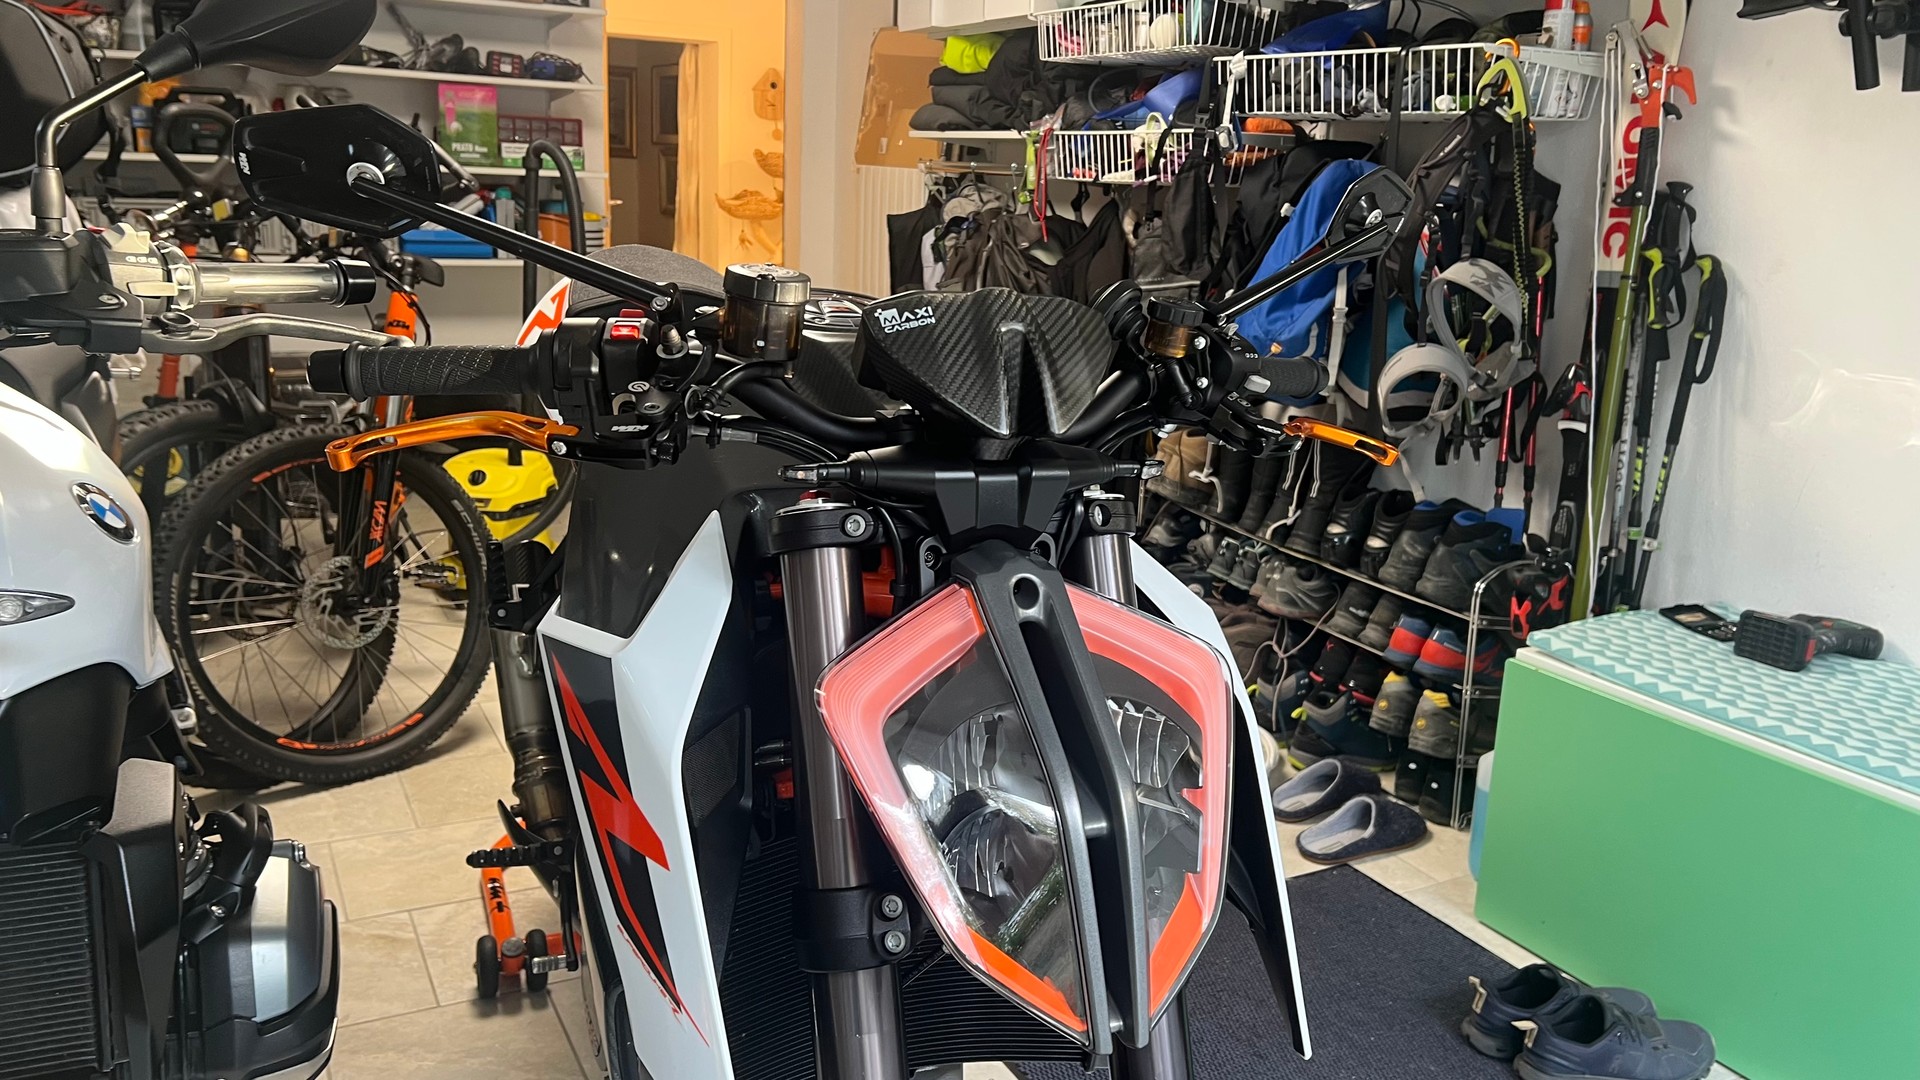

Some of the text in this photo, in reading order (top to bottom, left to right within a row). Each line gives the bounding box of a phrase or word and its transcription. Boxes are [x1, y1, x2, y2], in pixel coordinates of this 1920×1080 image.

[238, 151, 251, 176] KTM
[875, 305, 934, 327] MAXI
[884, 316, 936, 334] CARBON
